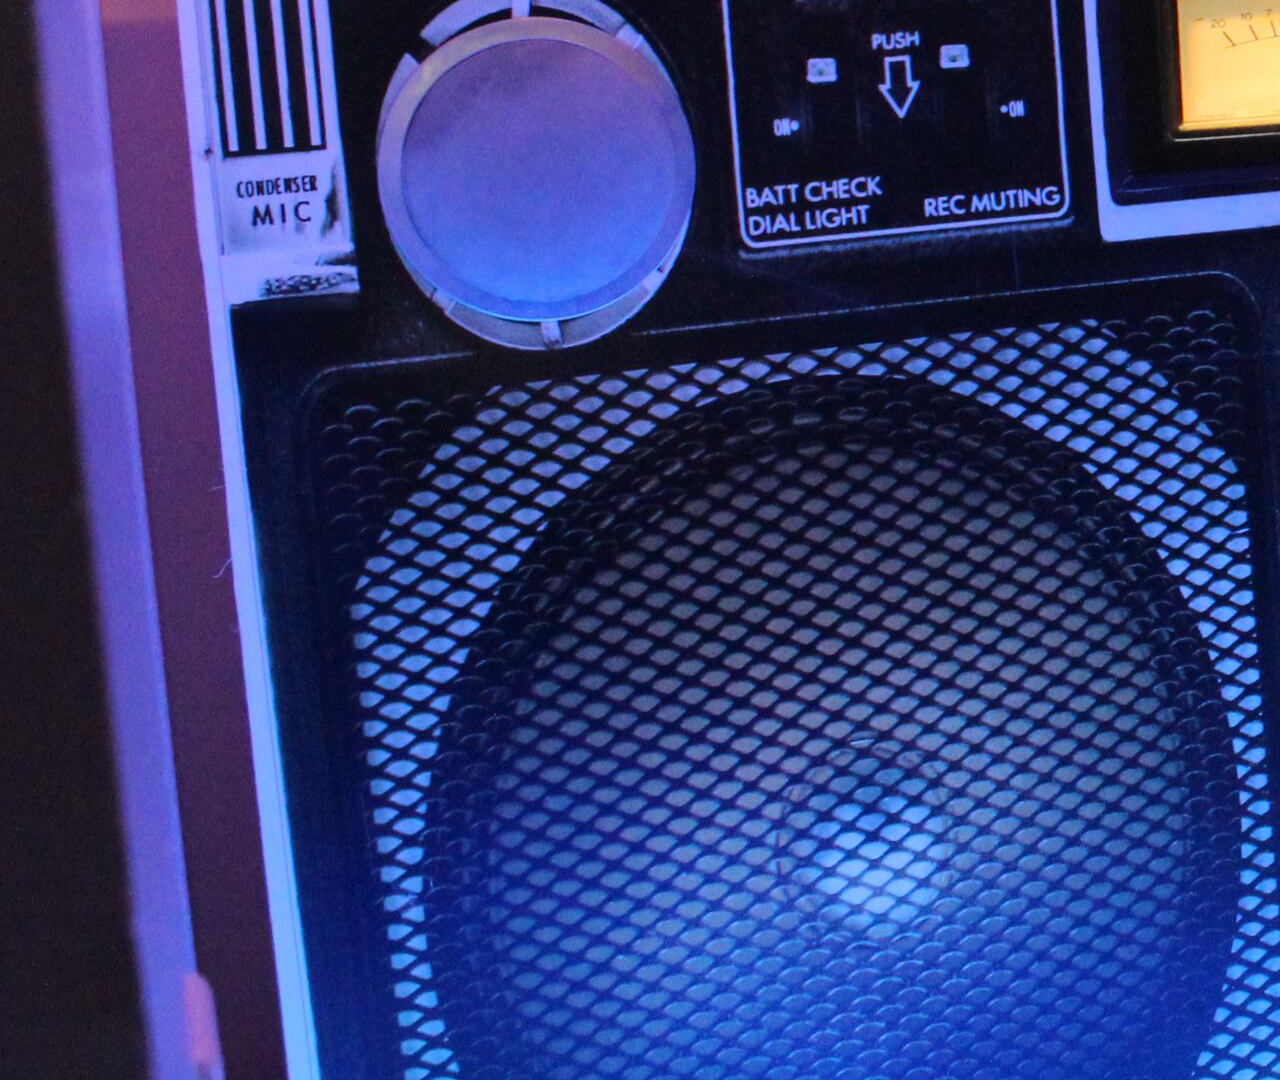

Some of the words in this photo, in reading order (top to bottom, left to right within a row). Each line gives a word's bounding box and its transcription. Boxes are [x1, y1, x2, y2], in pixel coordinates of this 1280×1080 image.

[872, 32, 920, 50] PUSH
[1009, 100, 1024, 117] ON
[237, 175, 318, 198] CONDENSER
[745, 183, 800, 208] BATT
[804, 176, 882, 201] CHECK
[252, 201, 311, 227] MIC
[924, 196, 966, 217] REC
[971, 186, 1061, 212] MUTING
[747, 207, 803, 236] DIAL
[805, 206, 870, 230] LIGHT
